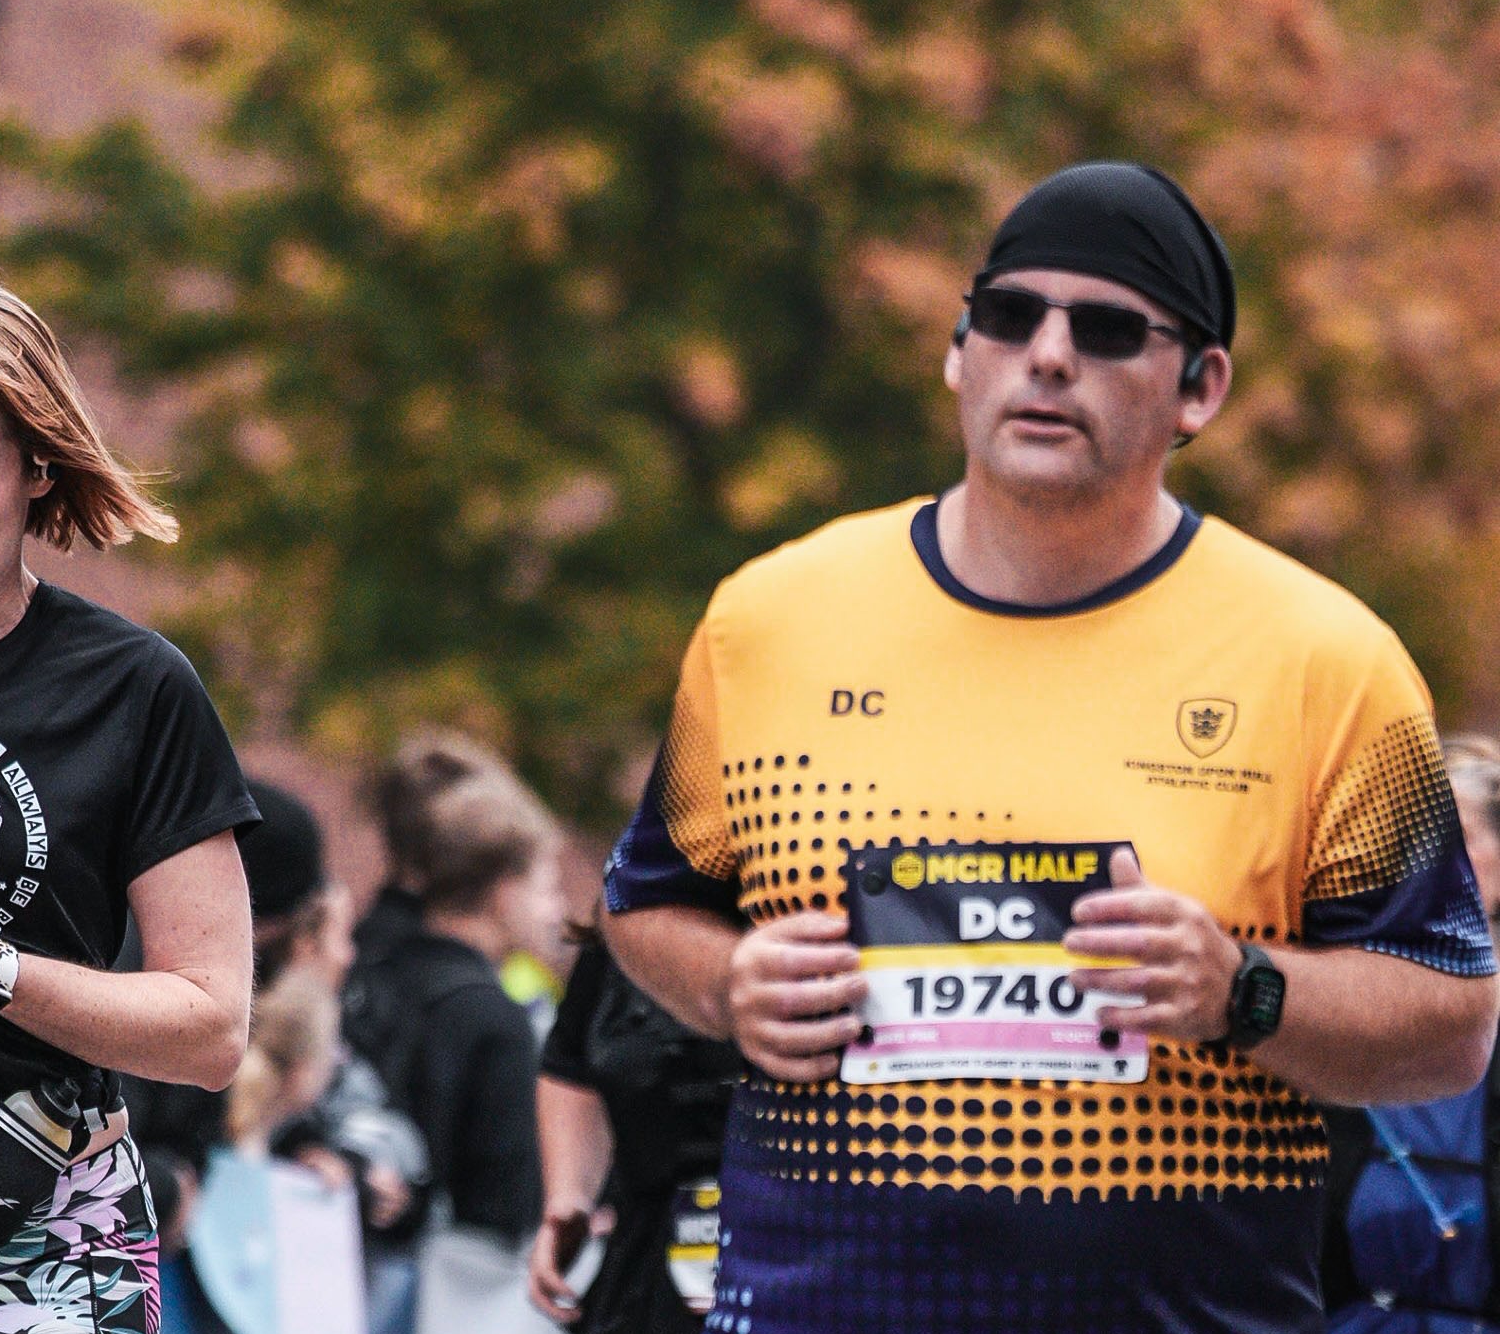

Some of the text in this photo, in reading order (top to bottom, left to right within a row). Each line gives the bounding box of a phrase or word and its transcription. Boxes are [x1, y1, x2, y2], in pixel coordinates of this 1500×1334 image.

[830, 689, 886, 717] DC
[1, 761, 48, 870] ALWAYS
[926, 850, 1099, 884] MCR HALF
[10, 876, 40, 907] BE
[958, 895, 1036, 941] DC
[905, 973, 1085, 1017] 19740
